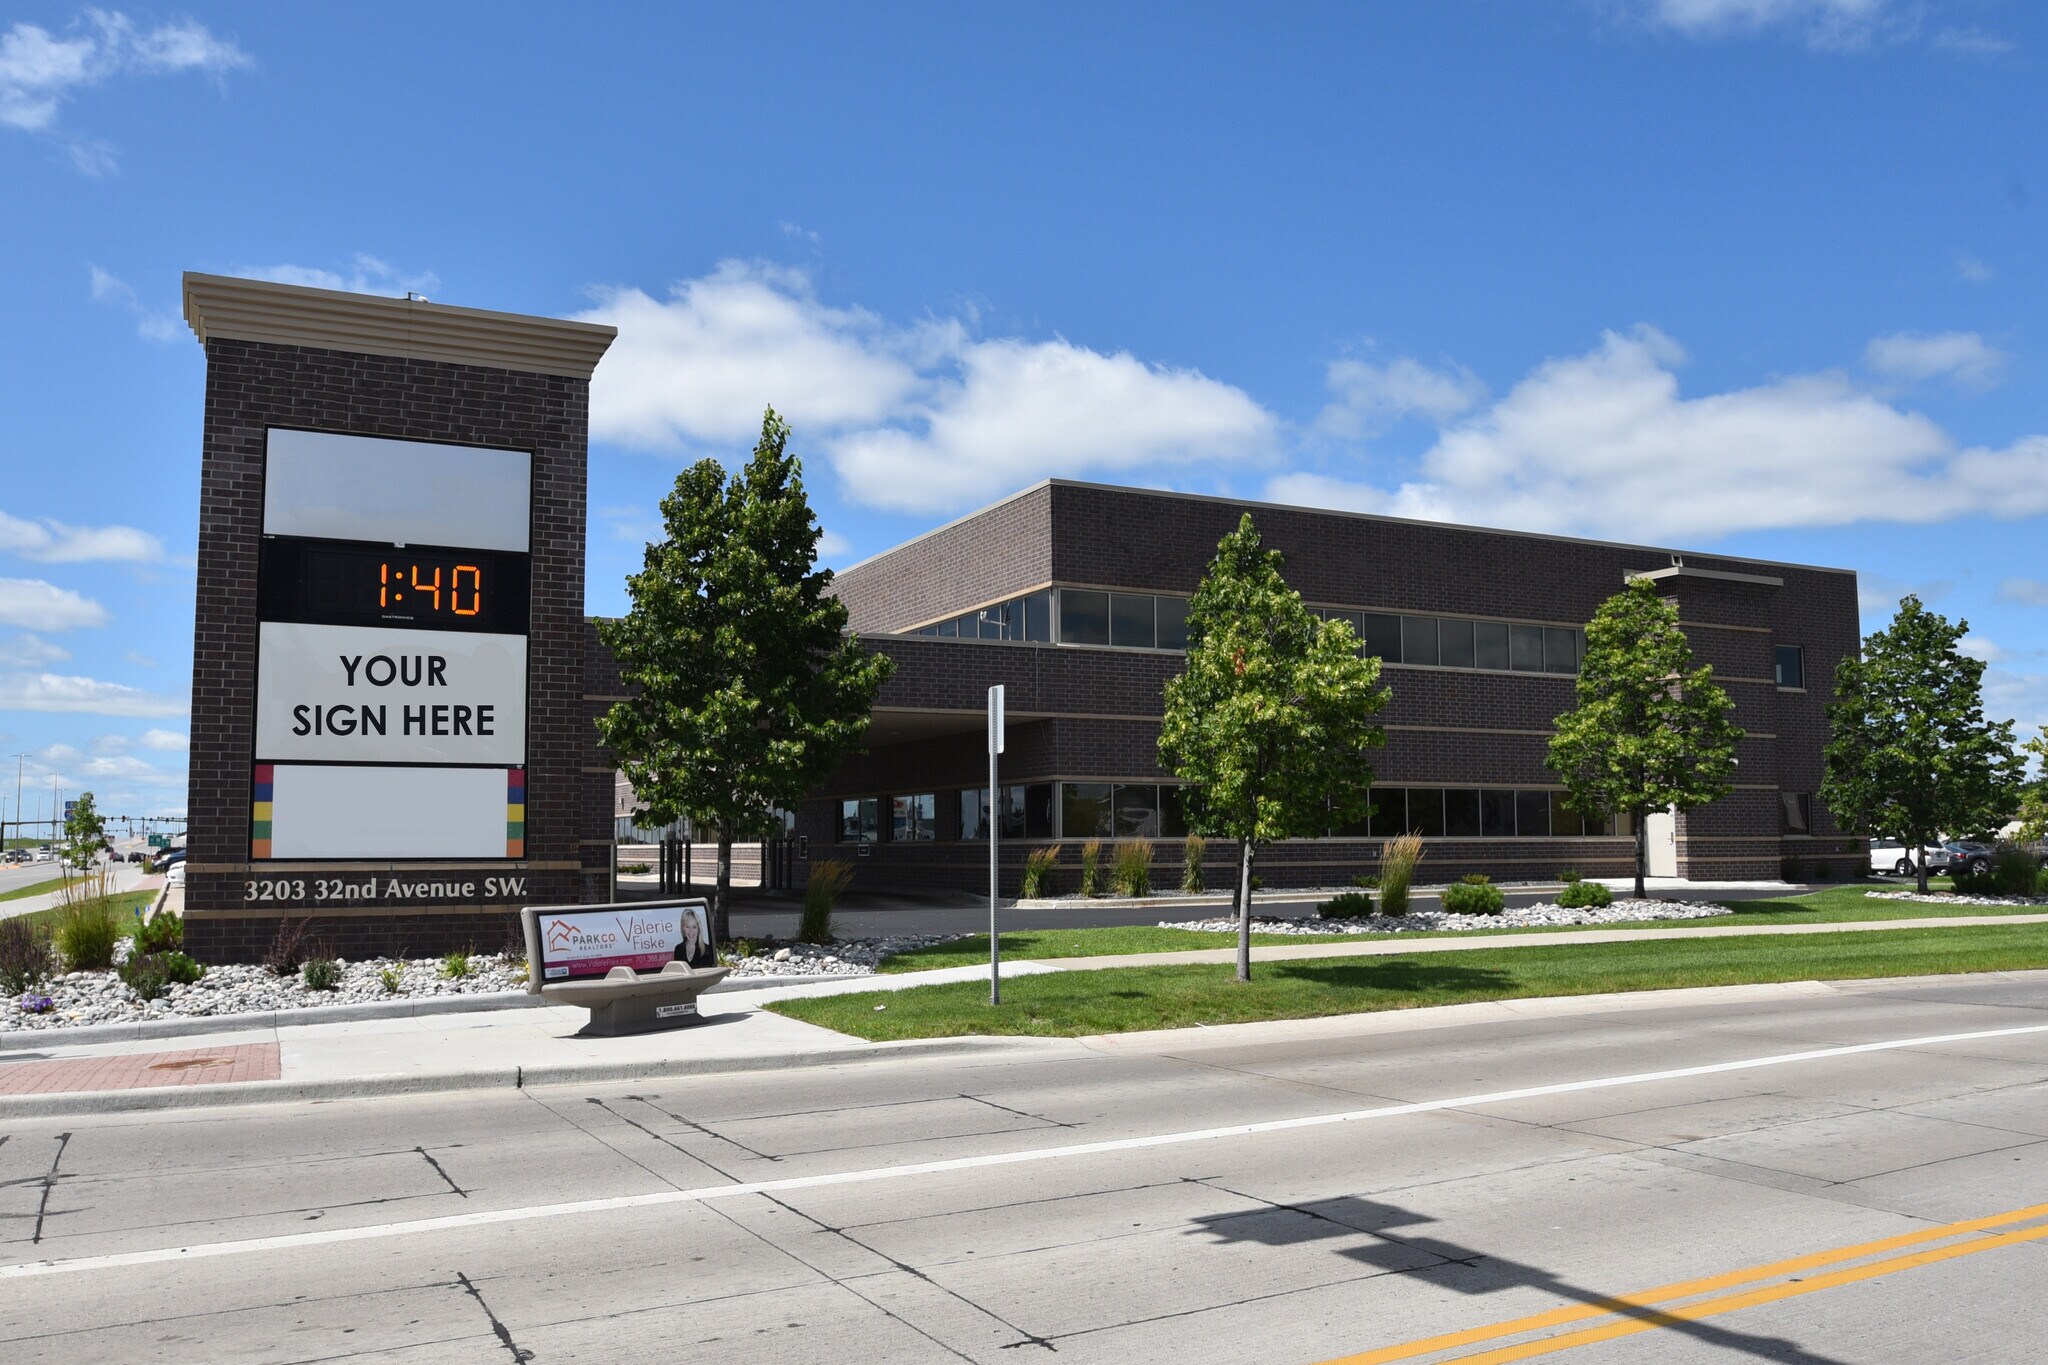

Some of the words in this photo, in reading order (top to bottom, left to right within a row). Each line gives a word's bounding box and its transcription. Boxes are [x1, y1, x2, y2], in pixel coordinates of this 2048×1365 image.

[380, 563, 480, 616] 1:40
[339, 655, 448, 687] YOUR
[291, 704, 387, 737] SIGN
[403, 705, 495, 736] HERE
[244, 880, 306, 901] 3203
[314, 878, 377, 900] 32nd
[384, 879, 475, 899] Avenue
[484, 877, 528, 898] SW.
[615, 916, 673, 943] Valerie
[632, 935, 665, 951] Fiske
